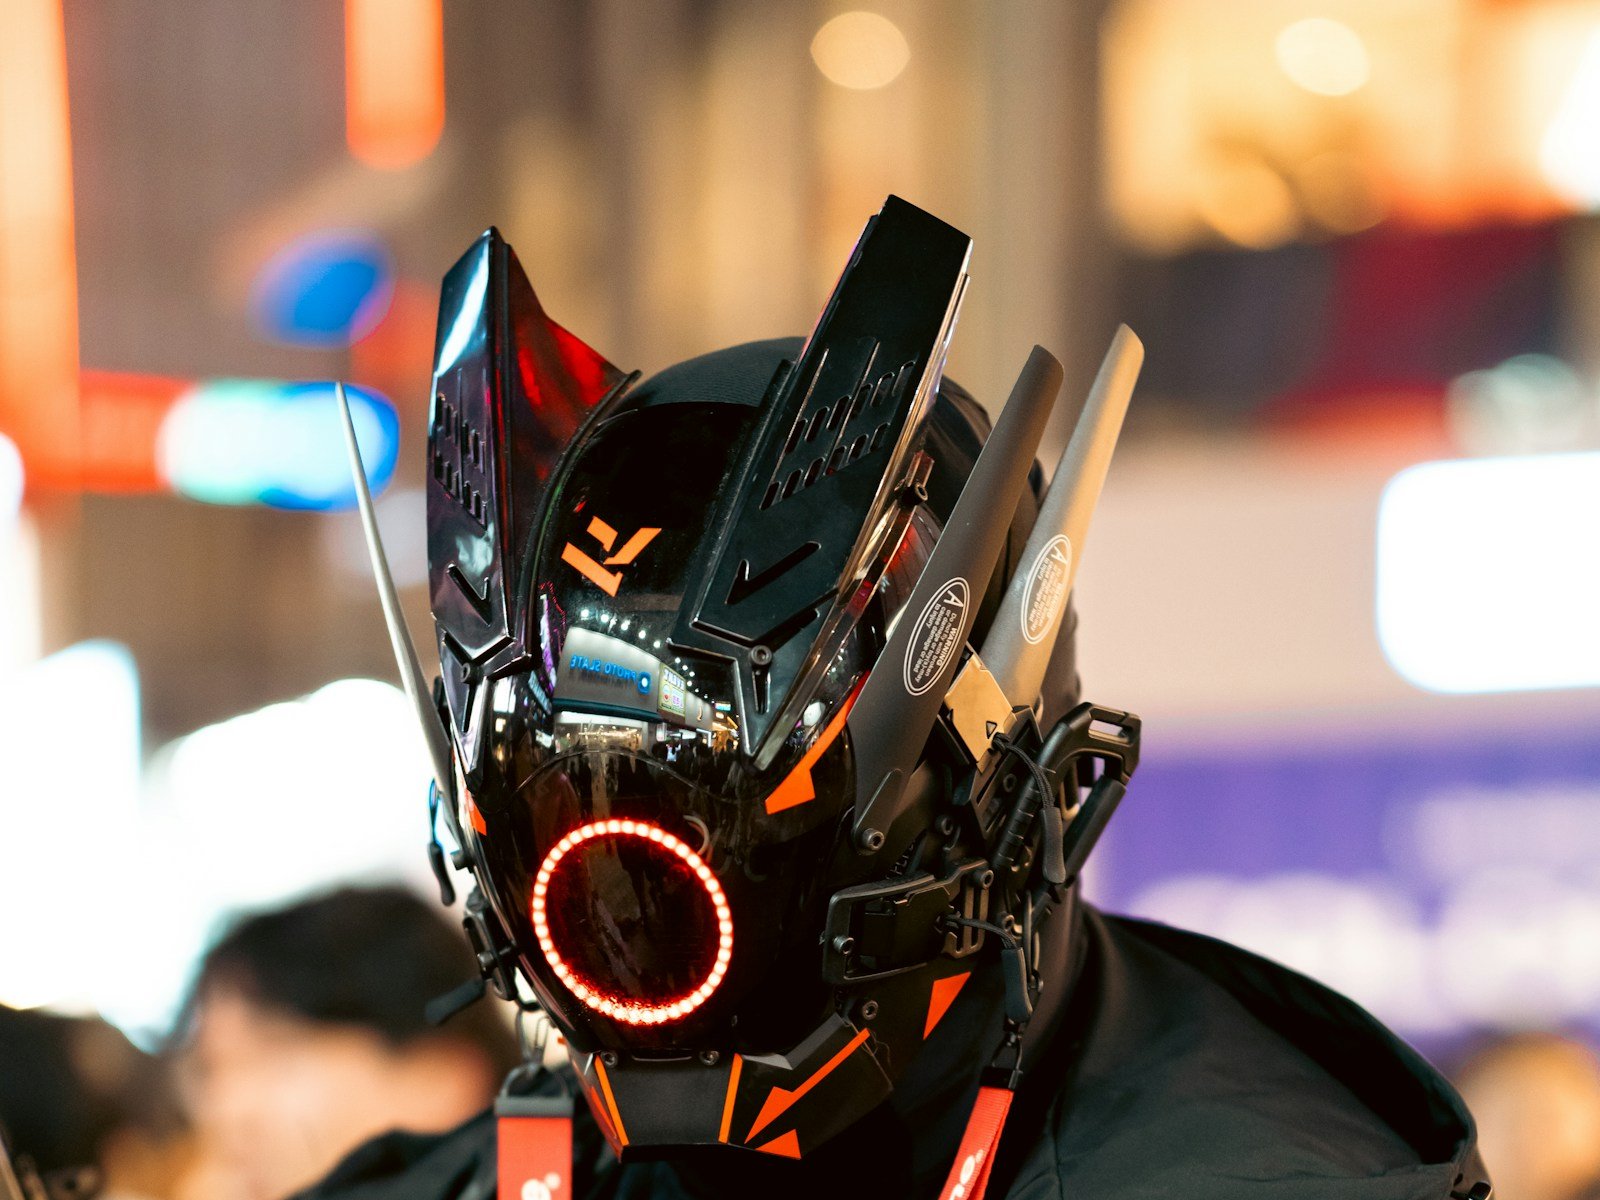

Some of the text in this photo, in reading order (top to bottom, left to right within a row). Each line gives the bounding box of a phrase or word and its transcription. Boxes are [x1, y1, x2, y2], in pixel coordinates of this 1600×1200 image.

[943, 590, 964, 608] A
[925, 609, 937, 628] injury
[934, 605, 946, 625] cause
[948, 612, 956, 622] Do
[933, 616, 948, 642] damage
[943, 622, 952, 633] not
[922, 625, 938, 651] damage
[935, 627, 957, 666] WARNING
[924, 654, 937, 677] broken
